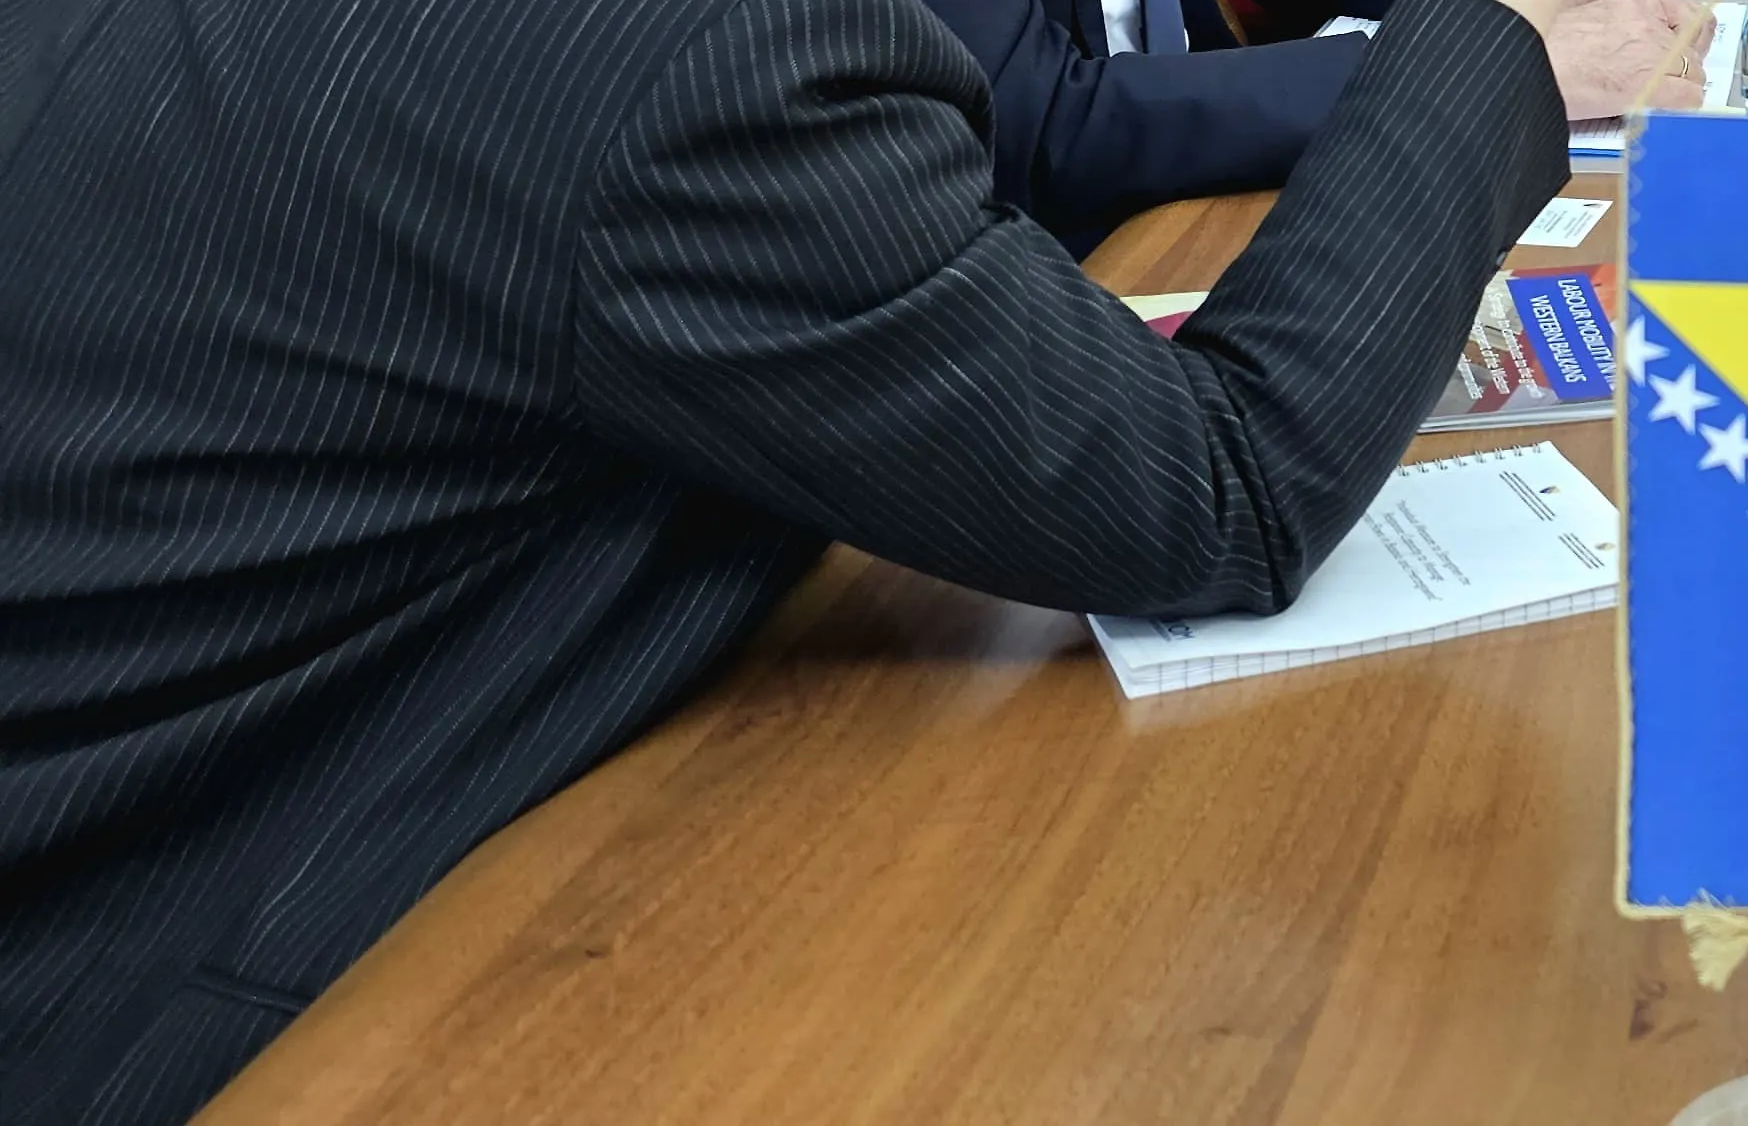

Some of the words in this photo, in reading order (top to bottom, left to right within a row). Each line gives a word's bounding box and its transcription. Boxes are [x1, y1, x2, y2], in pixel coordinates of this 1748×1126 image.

[1530, 295, 1566, 343] WESTERN
[1548, 342, 1587, 383] BALKANS
[1557, 279, 1592, 320] LABOUR
[1575, 319, 1614, 362] MOBILITY
[1596, 362, 1617, 375] IN
